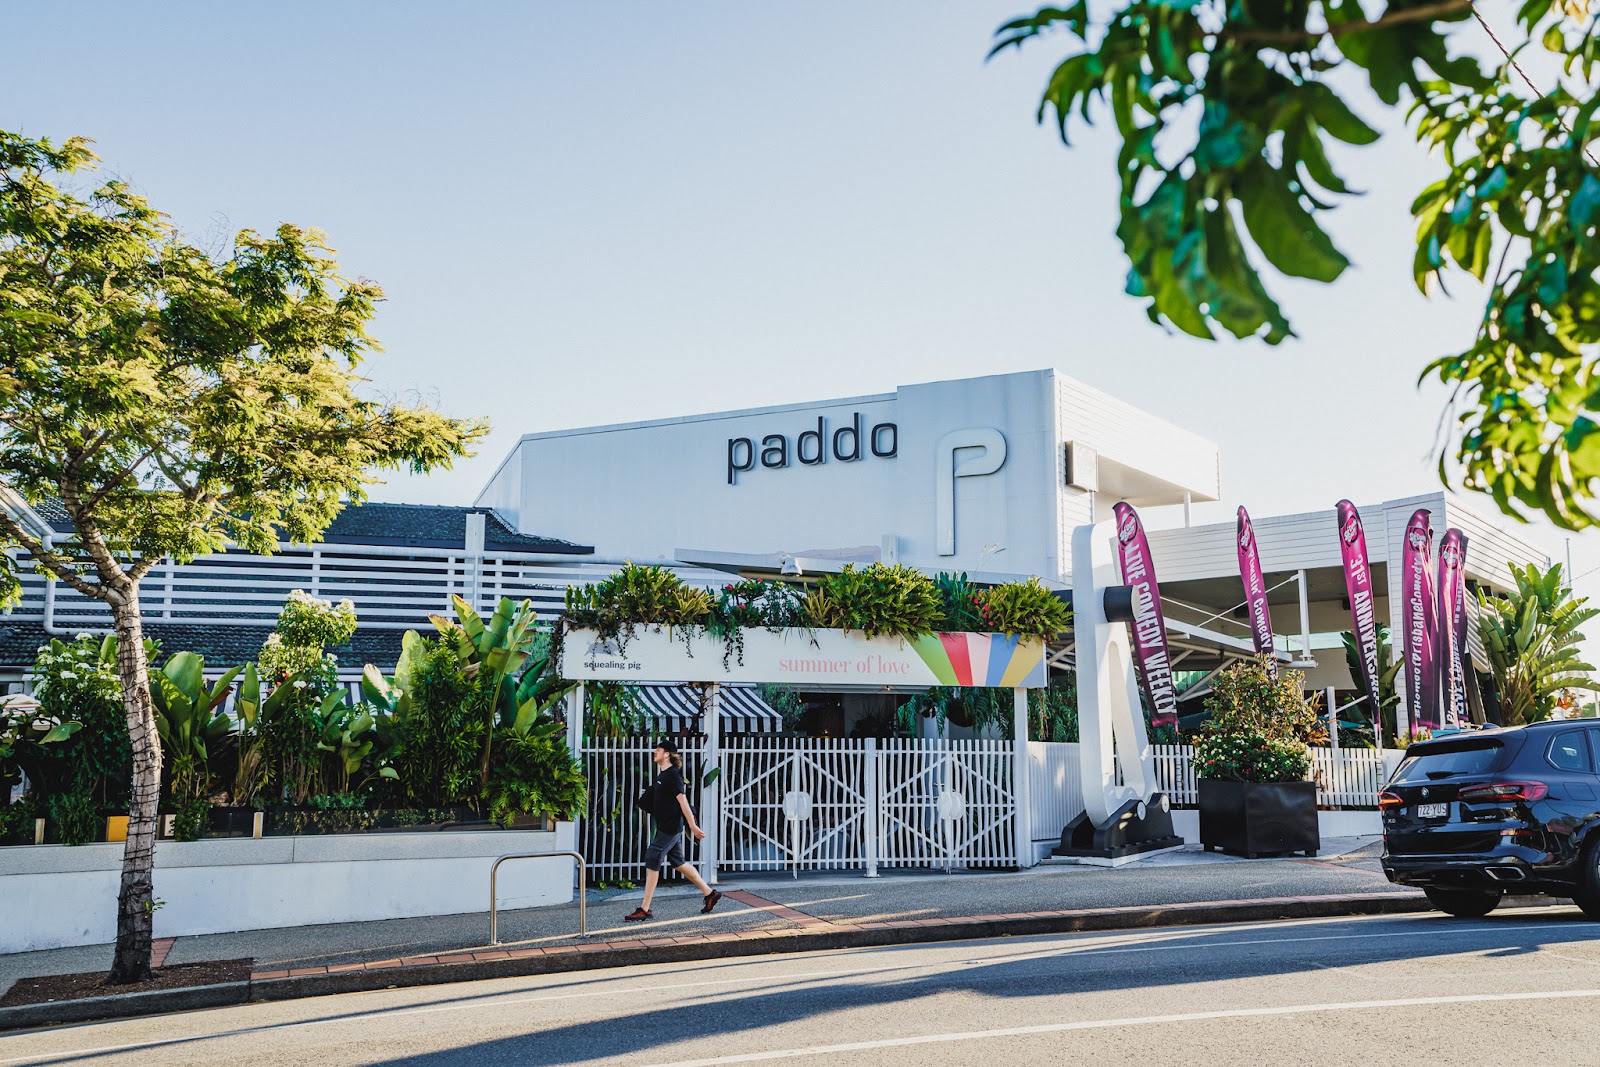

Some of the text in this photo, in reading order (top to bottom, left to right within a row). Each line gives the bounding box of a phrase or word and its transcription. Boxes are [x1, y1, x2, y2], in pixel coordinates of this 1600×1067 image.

[727, 412, 897, 484] paddo
[936, 426, 1007, 556] P
[1125, 544, 1146, 583] LIVE
[1349, 554, 1367, 585] 31ST
[1136, 581, 1163, 649] COMEDY
[1253, 598, 1272, 649] Comedy
[584, 661, 641, 670] squealing pig
[779, 655, 910, 675] summer of love
[1354, 592, 1379, 705] ANNIVERSA
[1144, 651, 1176, 714] WEEKLY
